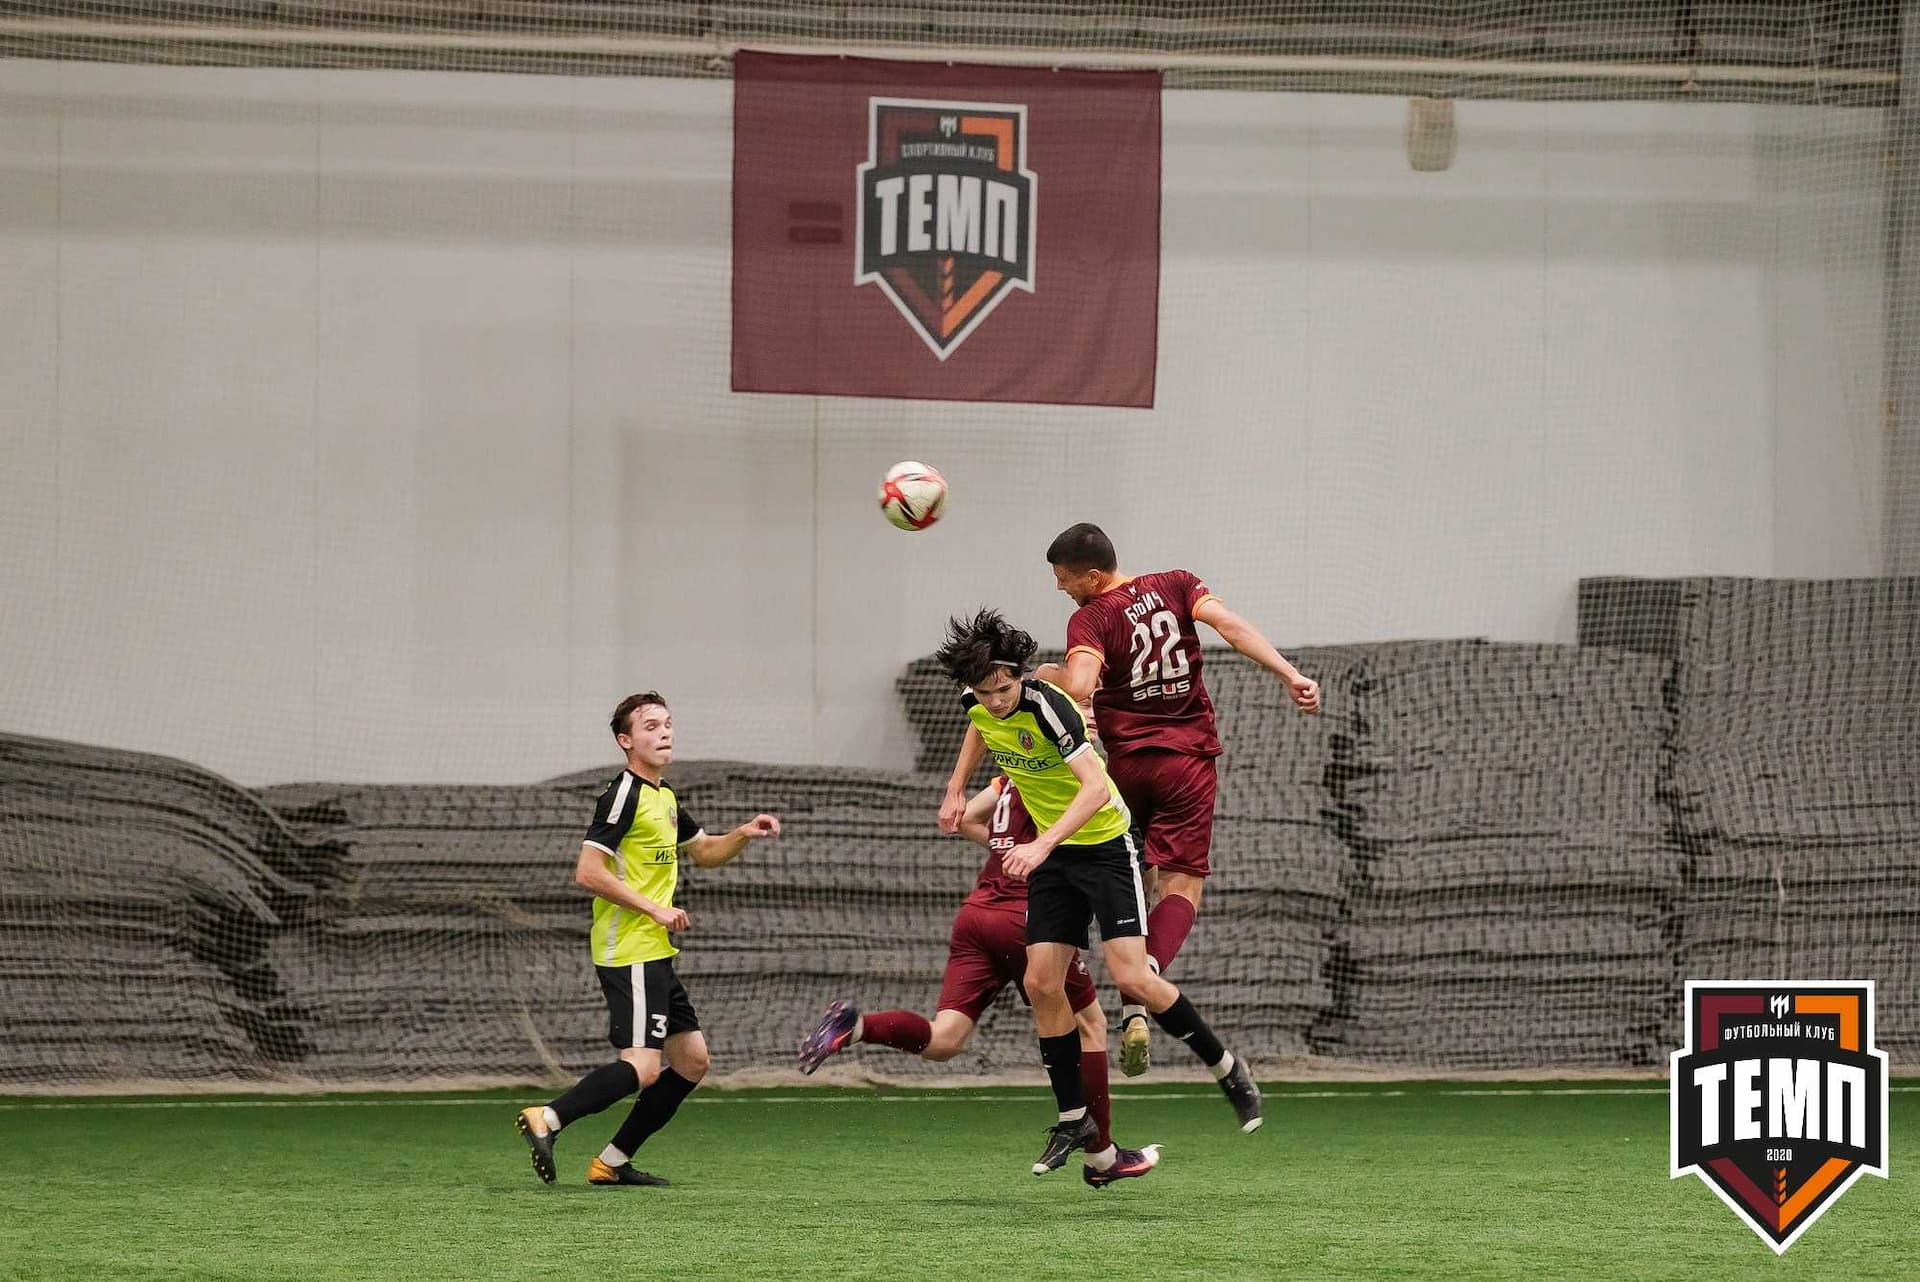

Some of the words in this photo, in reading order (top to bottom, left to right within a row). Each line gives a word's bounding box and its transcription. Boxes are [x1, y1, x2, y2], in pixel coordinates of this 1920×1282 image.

[875, 173, 1019, 264] ТЕМП
[1130, 610, 1190, 688] 22
[1133, 680, 1190, 701] SEUS
[651, 1014, 668, 1039] 3
